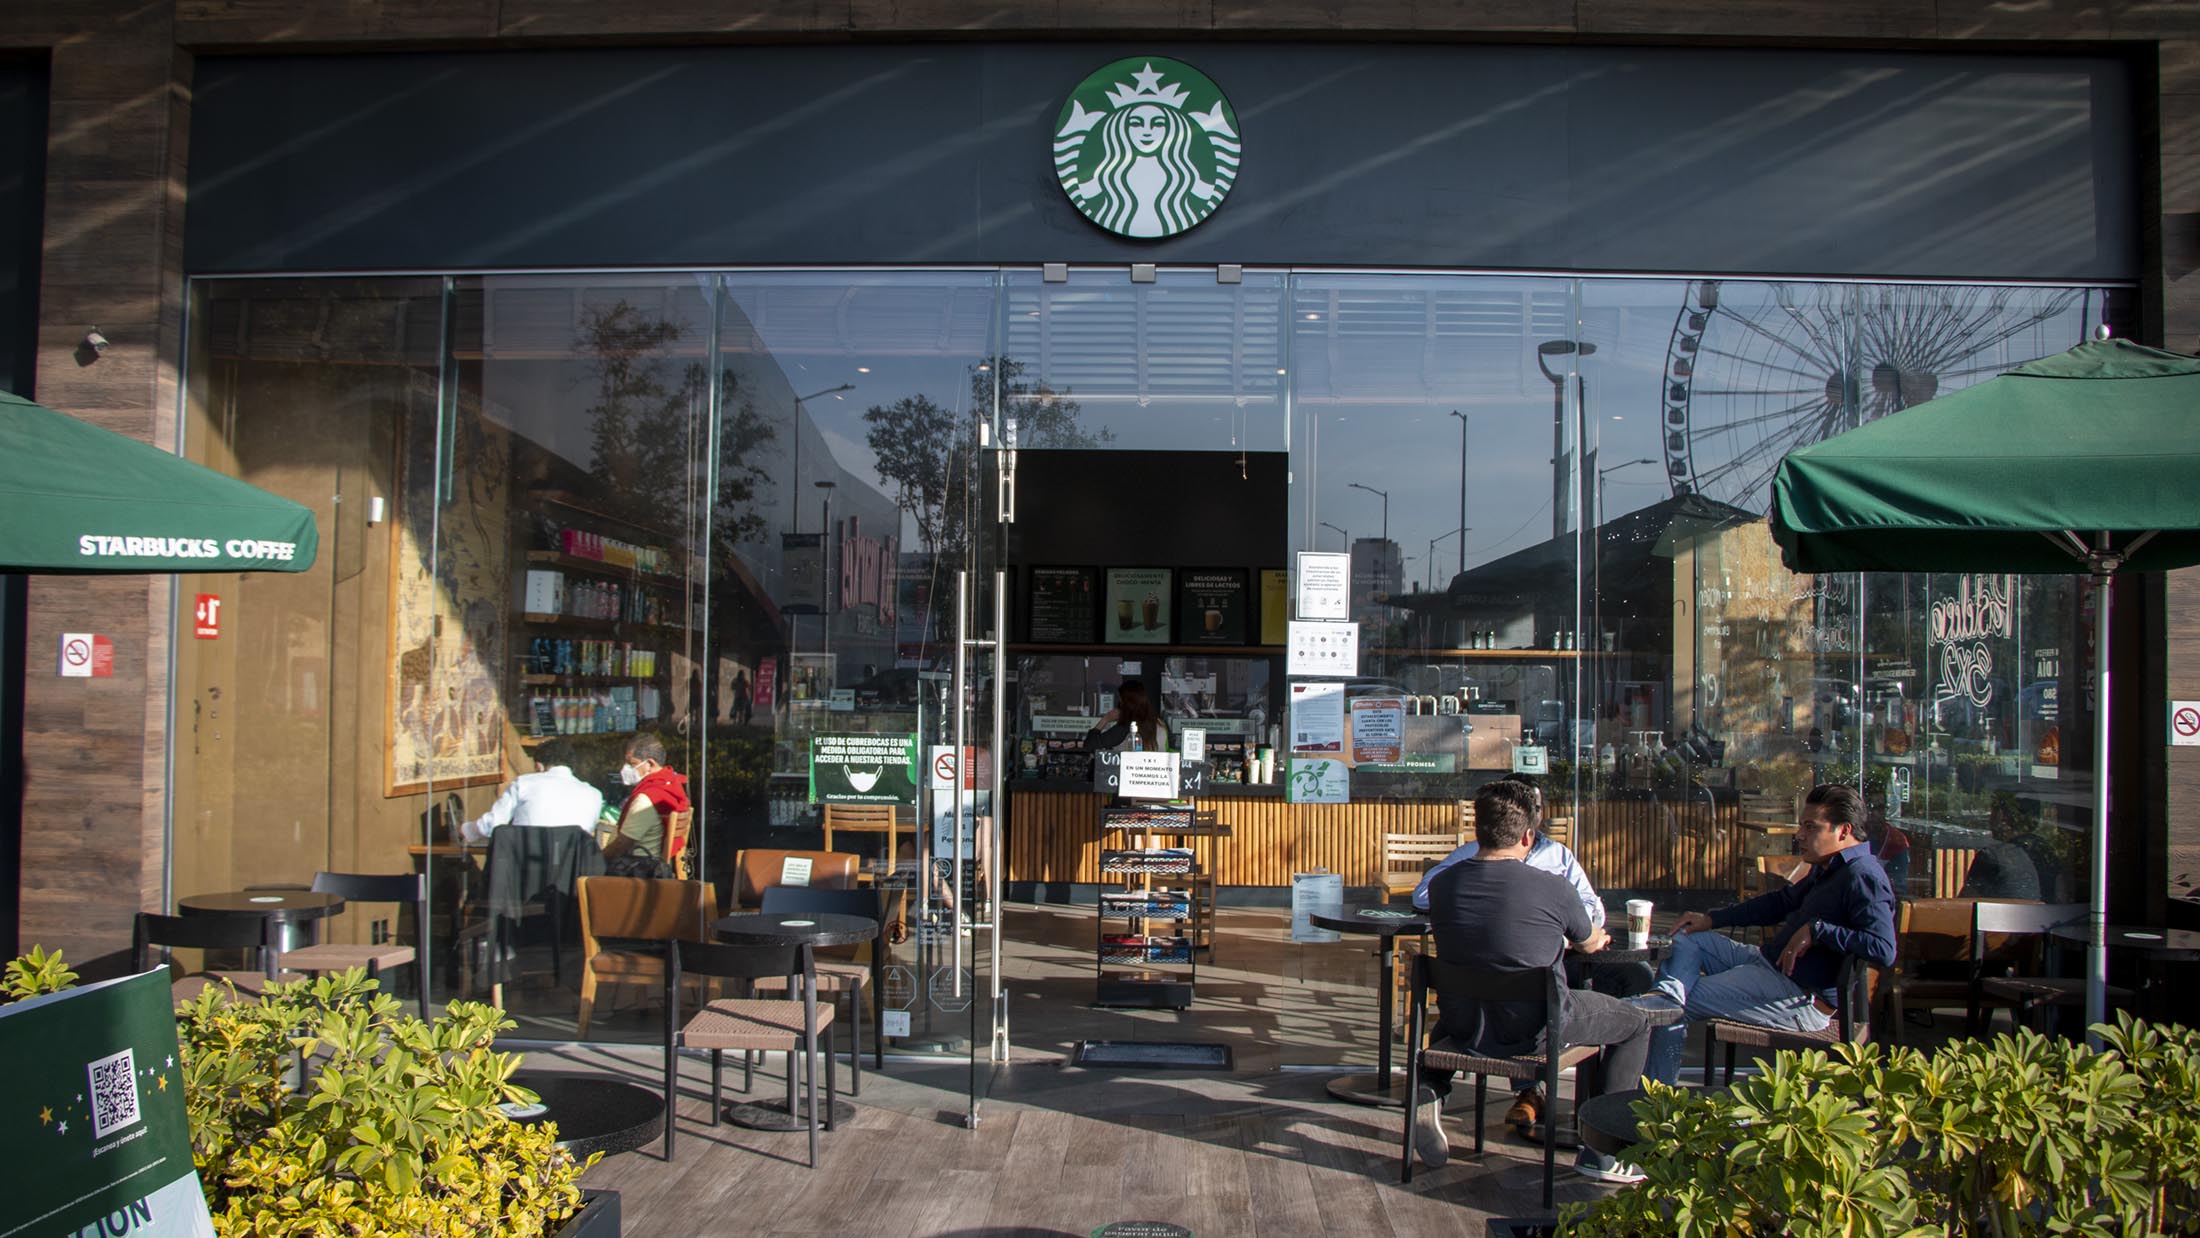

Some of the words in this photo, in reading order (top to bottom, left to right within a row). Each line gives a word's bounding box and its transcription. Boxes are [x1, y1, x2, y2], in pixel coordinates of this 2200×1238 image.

[79, 535, 220, 558] STARBUCKS
[225, 540, 297, 561] COFFEE
[815, 737, 822, 745] EL
[823, 737, 836, 745] USO
[846, 738, 890, 746] CUBREBOCAS
[890, 738, 898, 746] ES
[898, 738, 913, 746] UNA
[821, 746, 846, 754] MEDIDA
[847, 746, 888, 755] OBLIGATORIA
[889, 747, 906, 756] PARA
[815, 755, 844, 763] ACCEDER
[850, 755, 882, 764] NUESTRAS
[883, 756, 912, 765] TIENDAS.
[120, 1134, 135, 1145] únete
